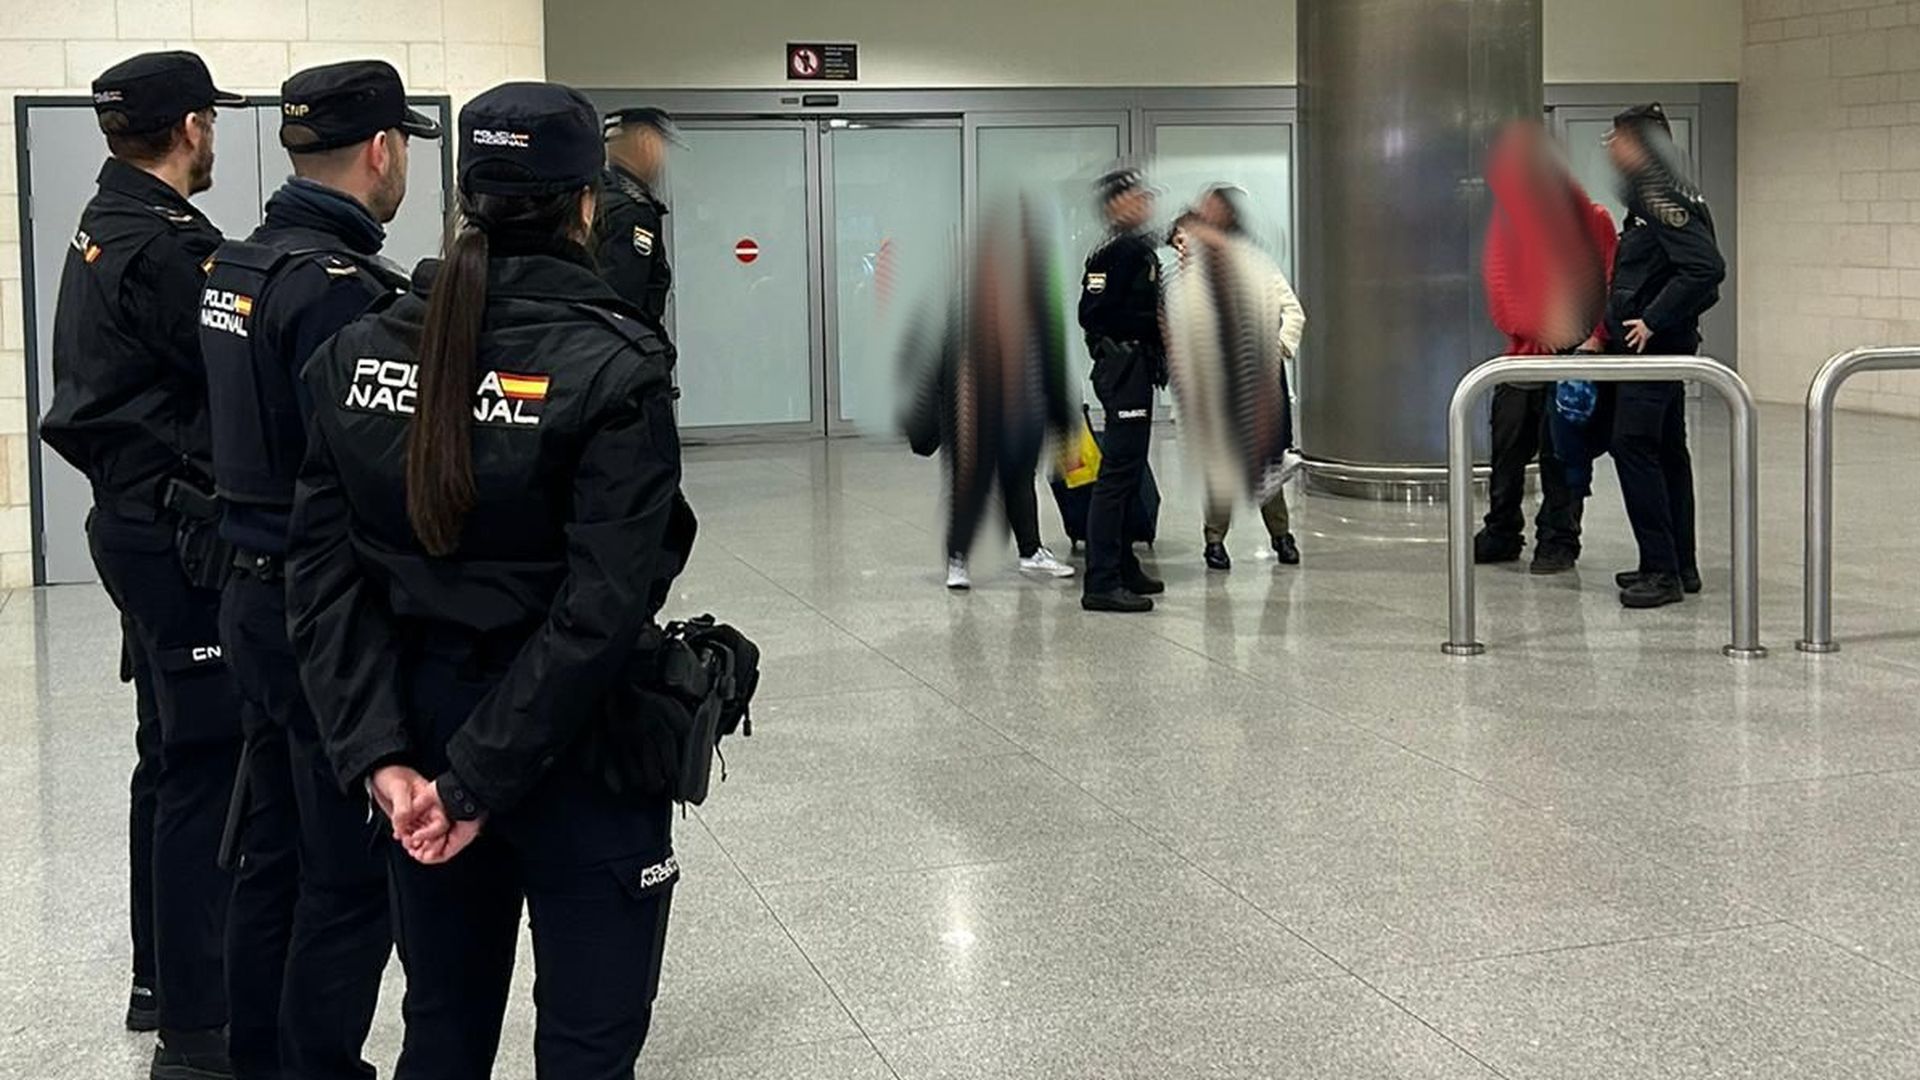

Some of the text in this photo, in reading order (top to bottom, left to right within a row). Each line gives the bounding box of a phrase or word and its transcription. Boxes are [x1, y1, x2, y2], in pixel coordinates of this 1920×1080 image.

[353, 358, 505, 398] POLA
[345, 383, 540, 424] NACNAL
[192, 645, 222, 661] CN
